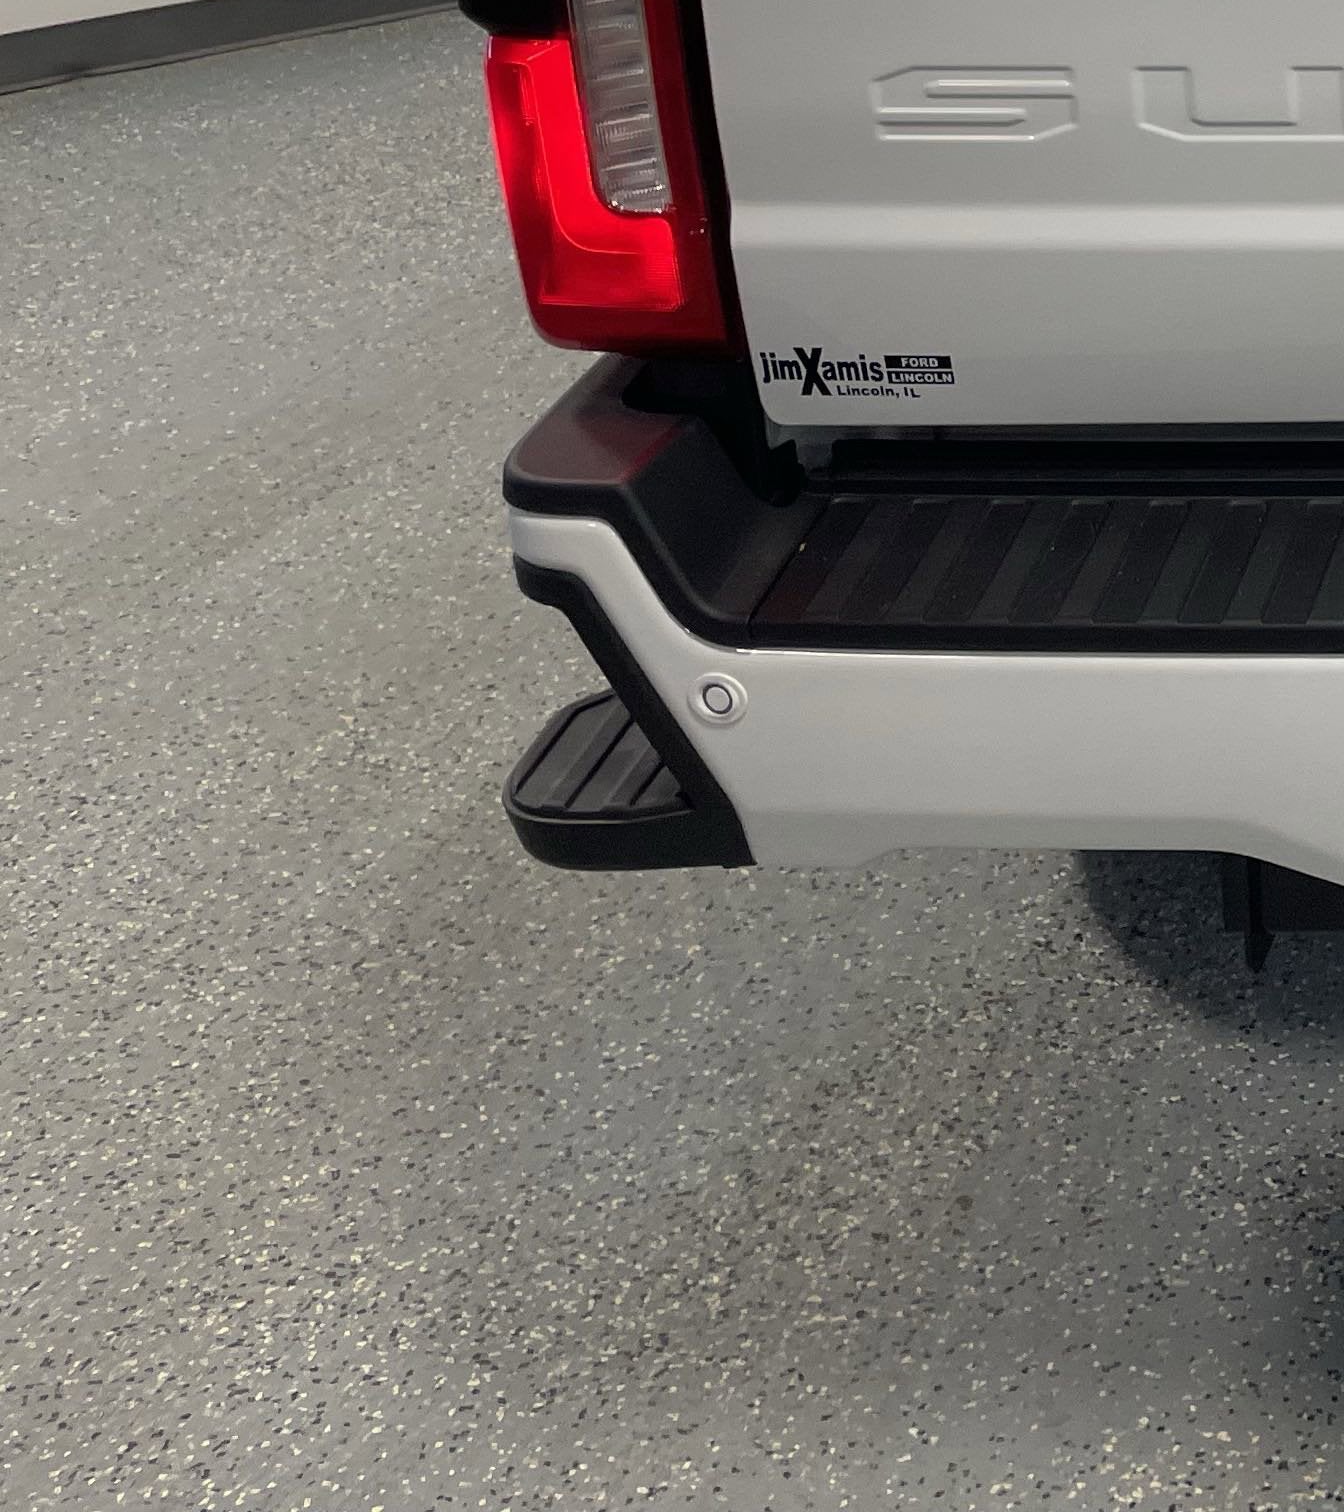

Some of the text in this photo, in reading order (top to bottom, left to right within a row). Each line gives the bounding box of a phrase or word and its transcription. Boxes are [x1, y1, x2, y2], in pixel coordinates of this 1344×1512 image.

[900, 357, 939, 368] FORD
[890, 373, 952, 383] LINCOLN
[836, 386, 921, 399] Lincoln, IL
